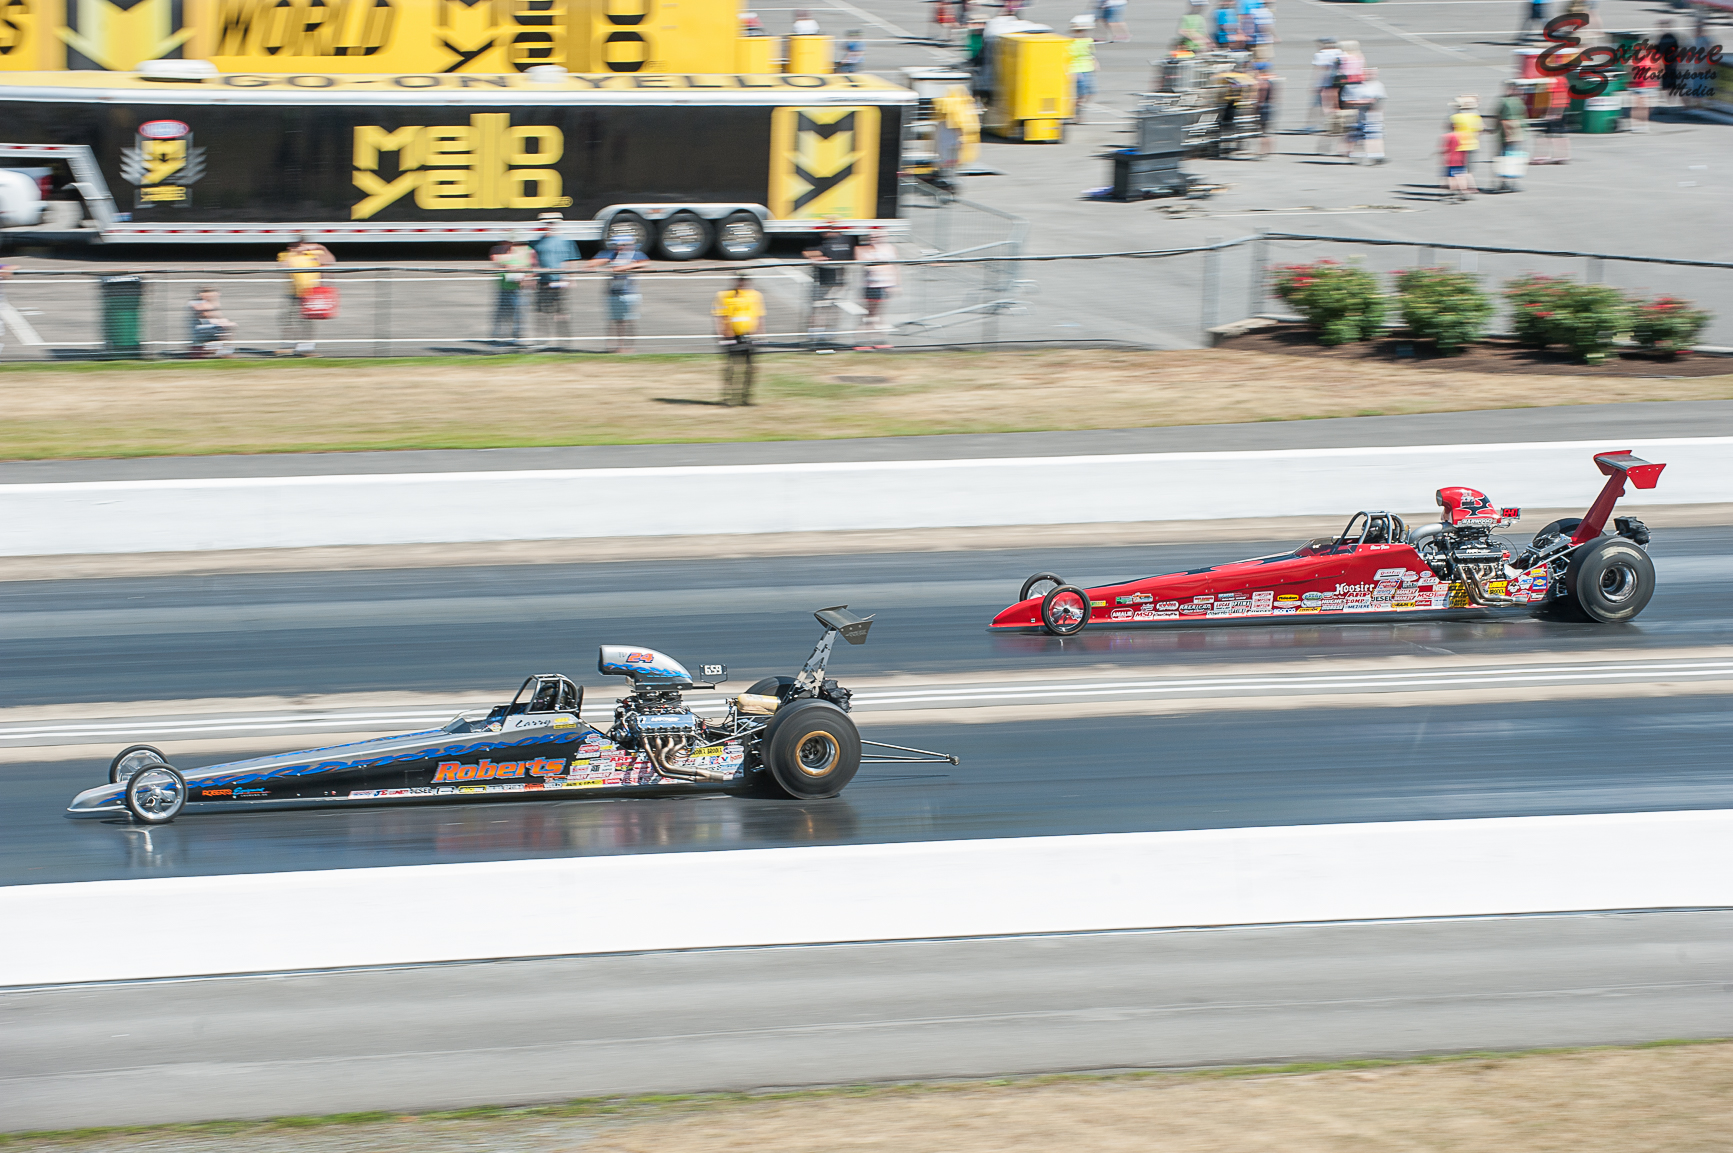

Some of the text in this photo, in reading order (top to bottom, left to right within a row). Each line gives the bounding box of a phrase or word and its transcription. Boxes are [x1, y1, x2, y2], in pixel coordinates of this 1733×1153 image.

[215, 0, 398, 57] WORLD
[1335, 581, 1375, 595] Hoosier
[627, 652, 655, 664] 24
[704, 664, 722, 676] 659
[431, 757, 567, 784] Roberts
